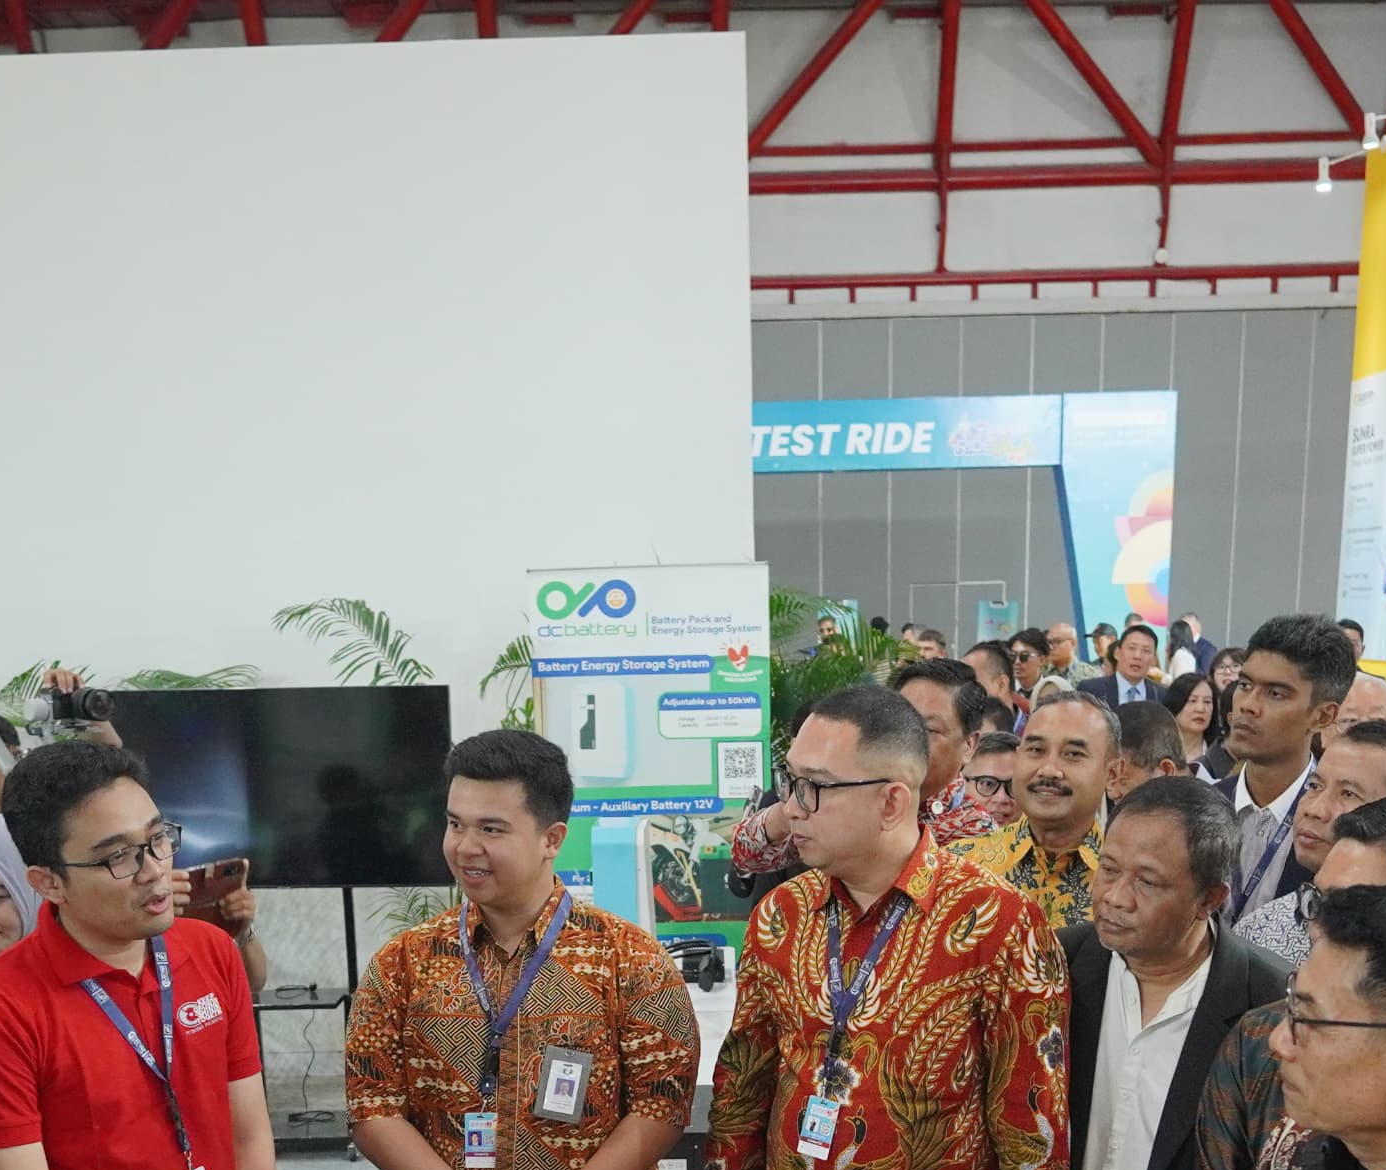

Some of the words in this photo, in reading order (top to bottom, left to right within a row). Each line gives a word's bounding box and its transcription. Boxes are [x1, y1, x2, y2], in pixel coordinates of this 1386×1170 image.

[752, 424, 840, 457] TEST
[845, 422, 935, 454] RIDE
[651, 616, 686, 625] Battery
[689, 615, 711, 624] Pack
[713, 614, 732, 623] and
[538, 623, 637, 638] dcbattery
[651, 626, 685, 637] Energy
[687, 625, 724, 636] Storage
[726, 624, 762, 634] System
[537, 661, 579, 674] Battery
[581, 661, 620, 674] Energy
[622, 660, 665, 672] Storage
[667, 659, 710, 671] System
[662, 698, 705, 708] Adjustable
[706, 698, 717, 707] up
[718, 697, 727, 705] to
[728, 696, 757, 704] 50kWh
[600, 802, 649, 814] Auxiliary
[652, 800, 692, 812] Battery
[694, 799, 714, 809] 12V
